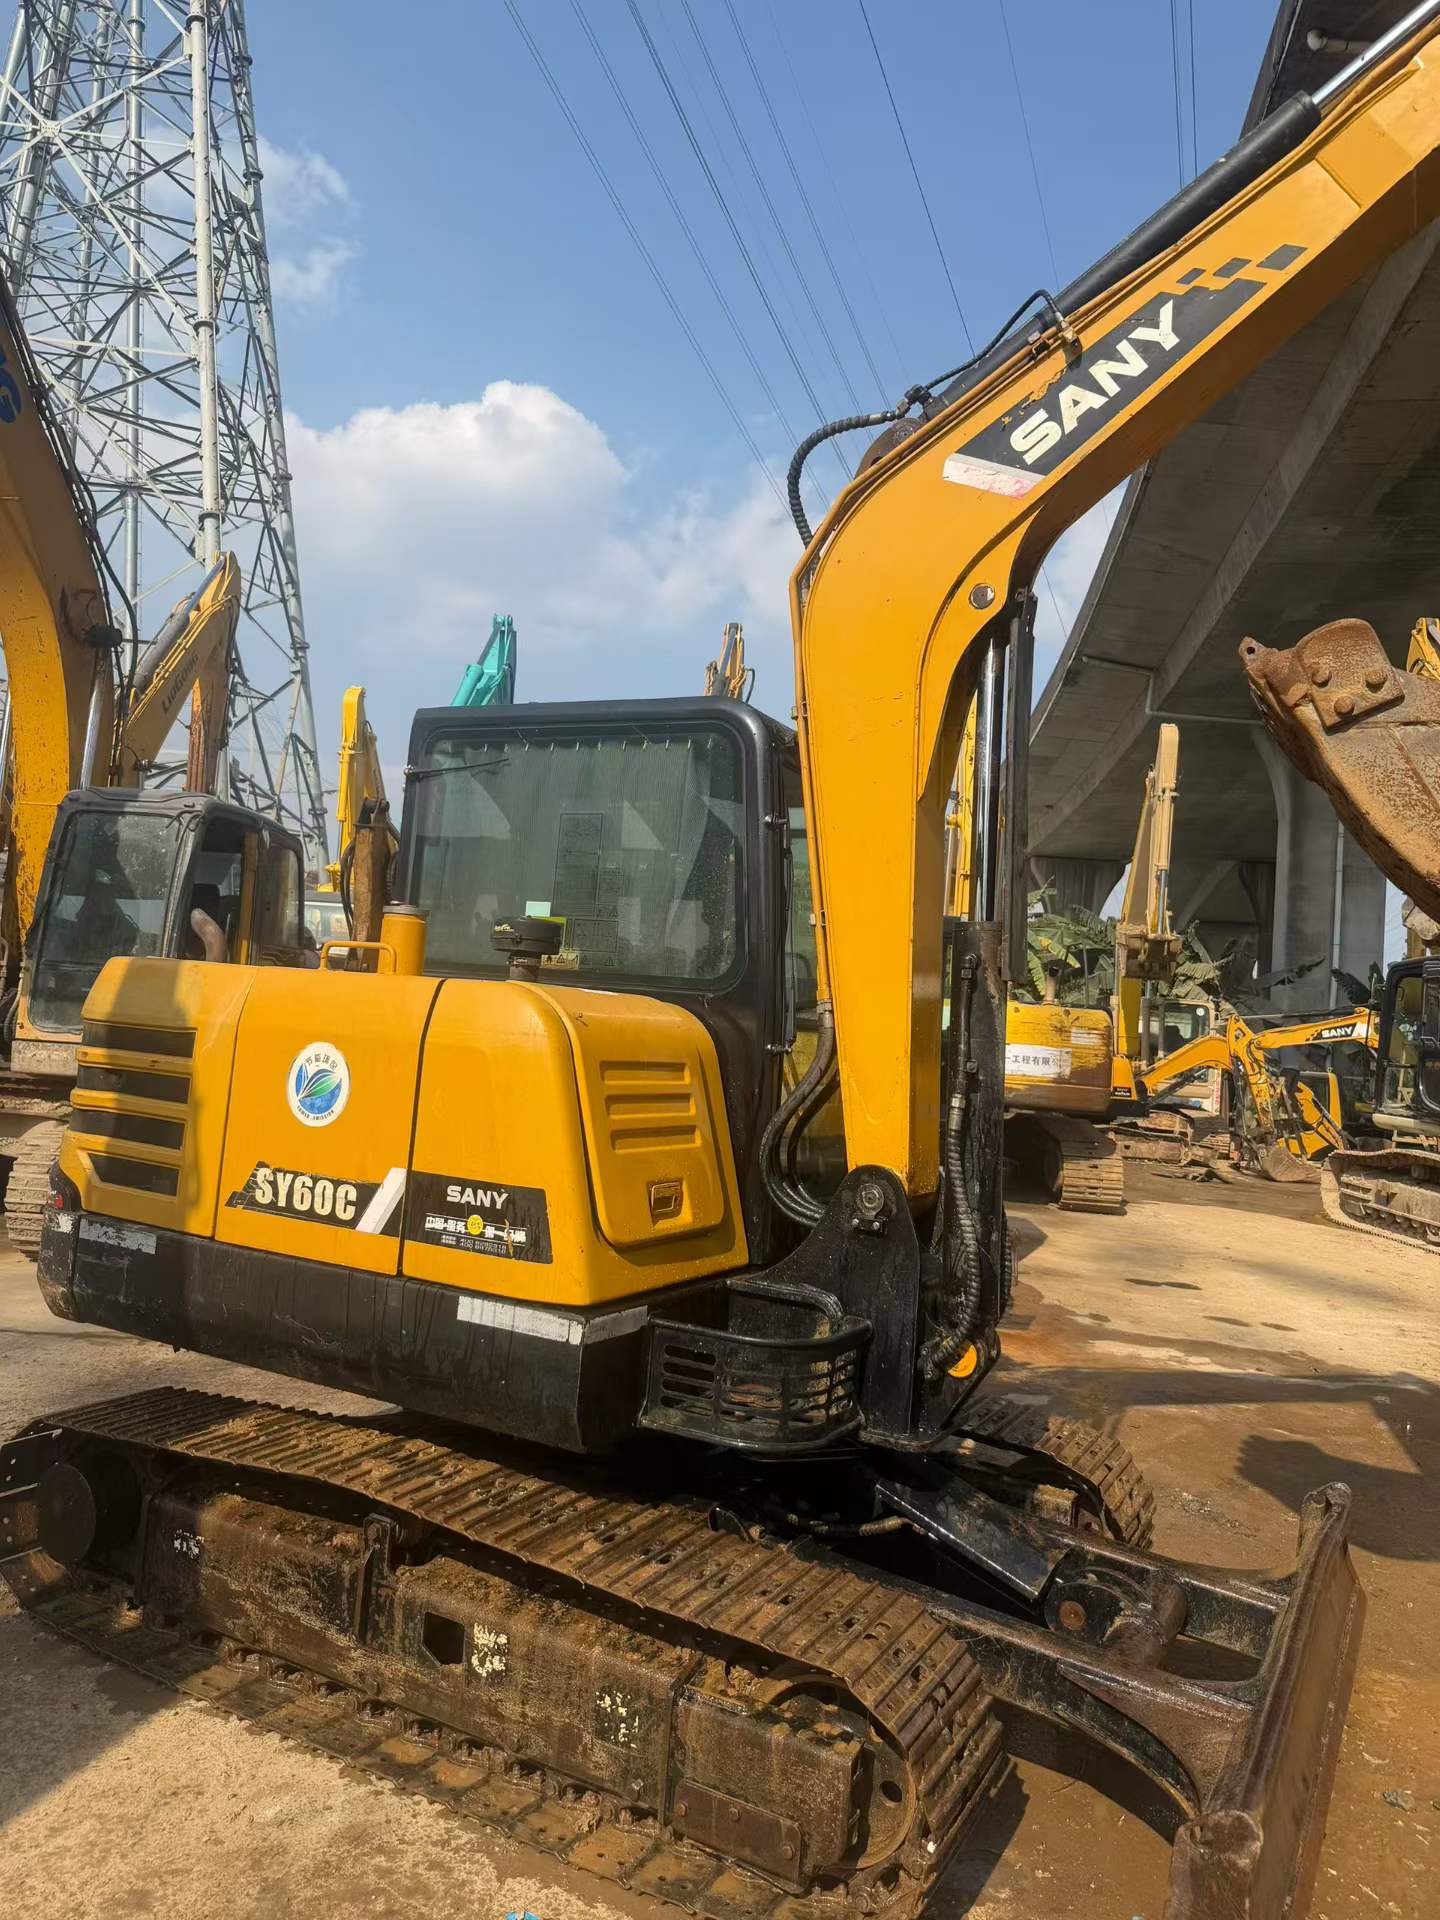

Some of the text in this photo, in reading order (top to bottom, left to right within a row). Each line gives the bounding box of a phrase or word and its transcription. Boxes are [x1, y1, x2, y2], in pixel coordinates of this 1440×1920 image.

[1010, 299, 1180, 466] SANY
[1321, 1026, 1353, 1038] SANY
[254, 1167, 357, 1221] SY60C
[446, 1185, 509, 1210] SANY
